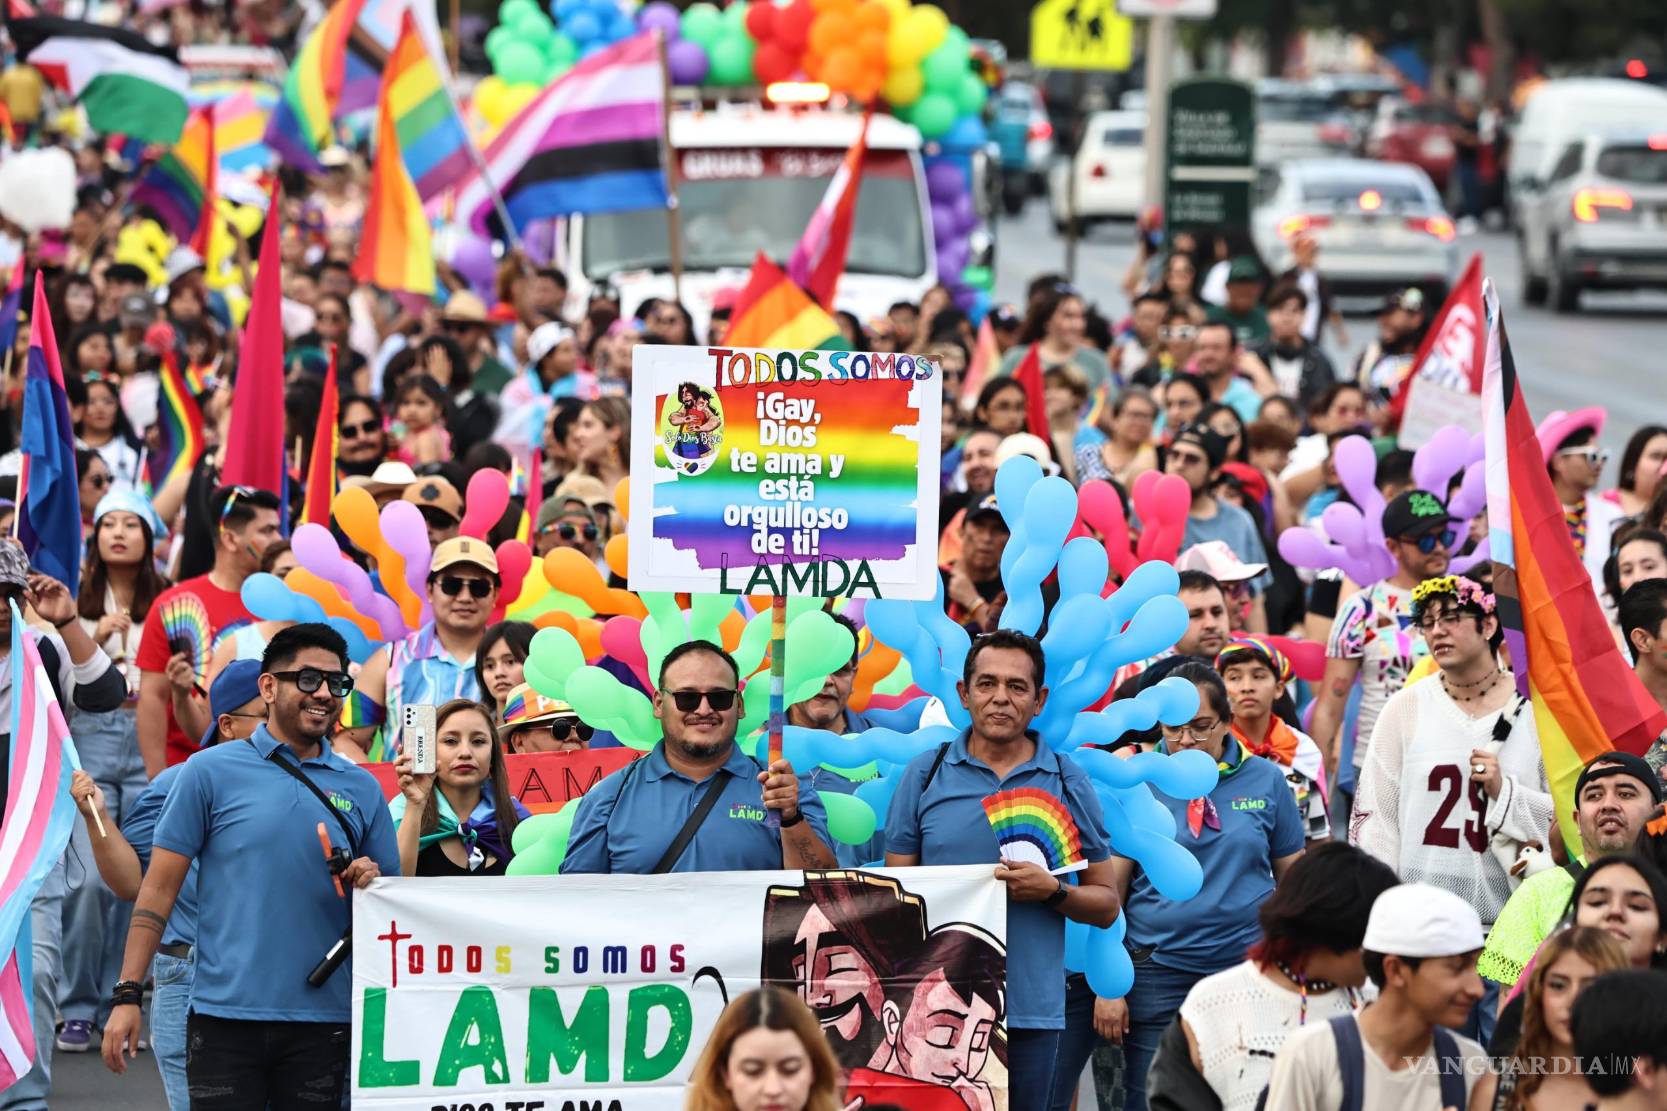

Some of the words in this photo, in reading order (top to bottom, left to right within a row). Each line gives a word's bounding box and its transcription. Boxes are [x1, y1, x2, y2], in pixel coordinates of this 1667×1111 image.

[708, 348, 822, 391] TODOS
[826, 351, 933, 386] SOMOS
[756, 391, 822, 422] ¡Gay,
[683, 431, 700, 444] Dios
[759, 420, 816, 447] Dios
[730, 448, 757, 473] te
[764, 453, 822, 474] ama
[829, 453, 845, 478] y
[759, 475, 814, 501] está
[723, 502, 849, 529] orgulloso
[751, 528, 784, 554] de
[792, 530, 820, 555] ti!
[720, 552, 882, 599] LAMDA
[330, 796, 351, 812] AMD
[544, 944, 685, 974] SOMOS
